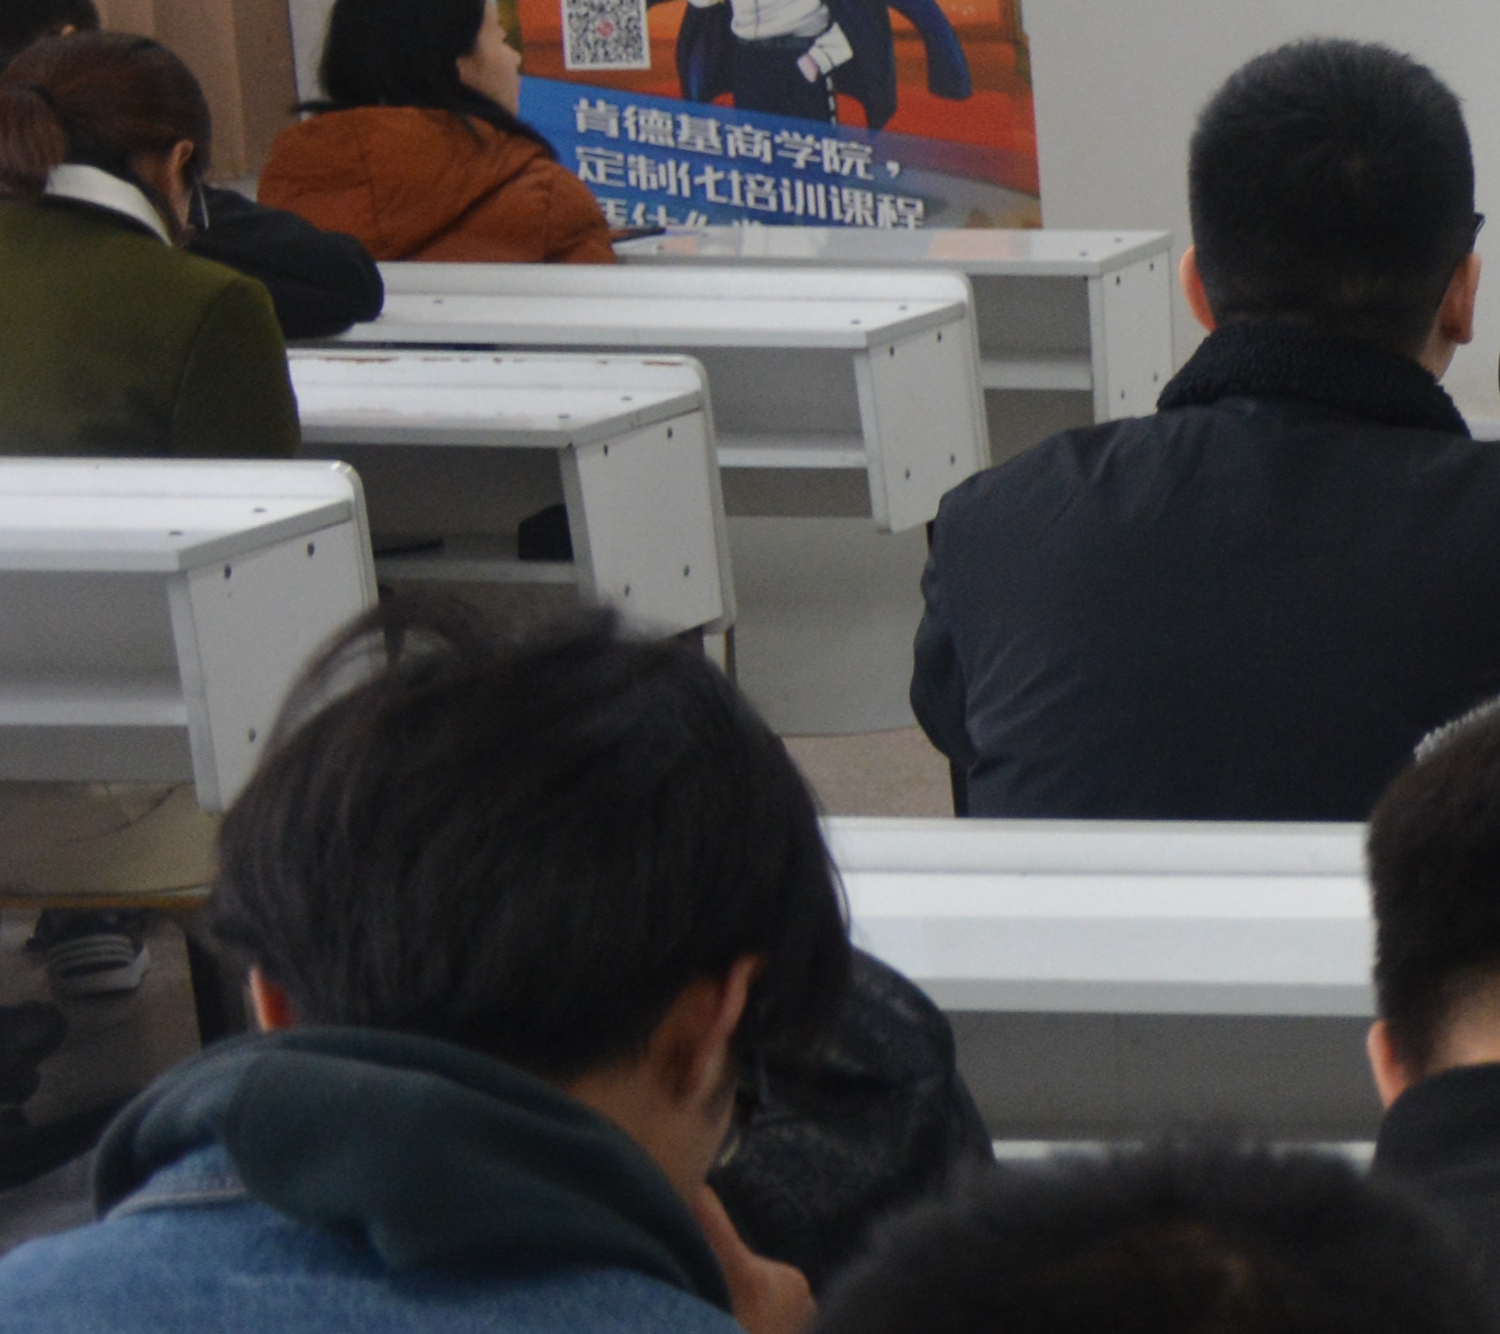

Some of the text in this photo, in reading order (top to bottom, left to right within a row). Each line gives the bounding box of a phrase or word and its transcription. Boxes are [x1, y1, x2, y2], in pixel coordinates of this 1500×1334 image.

[576, 146, 926, 229] 定制化培训课程
